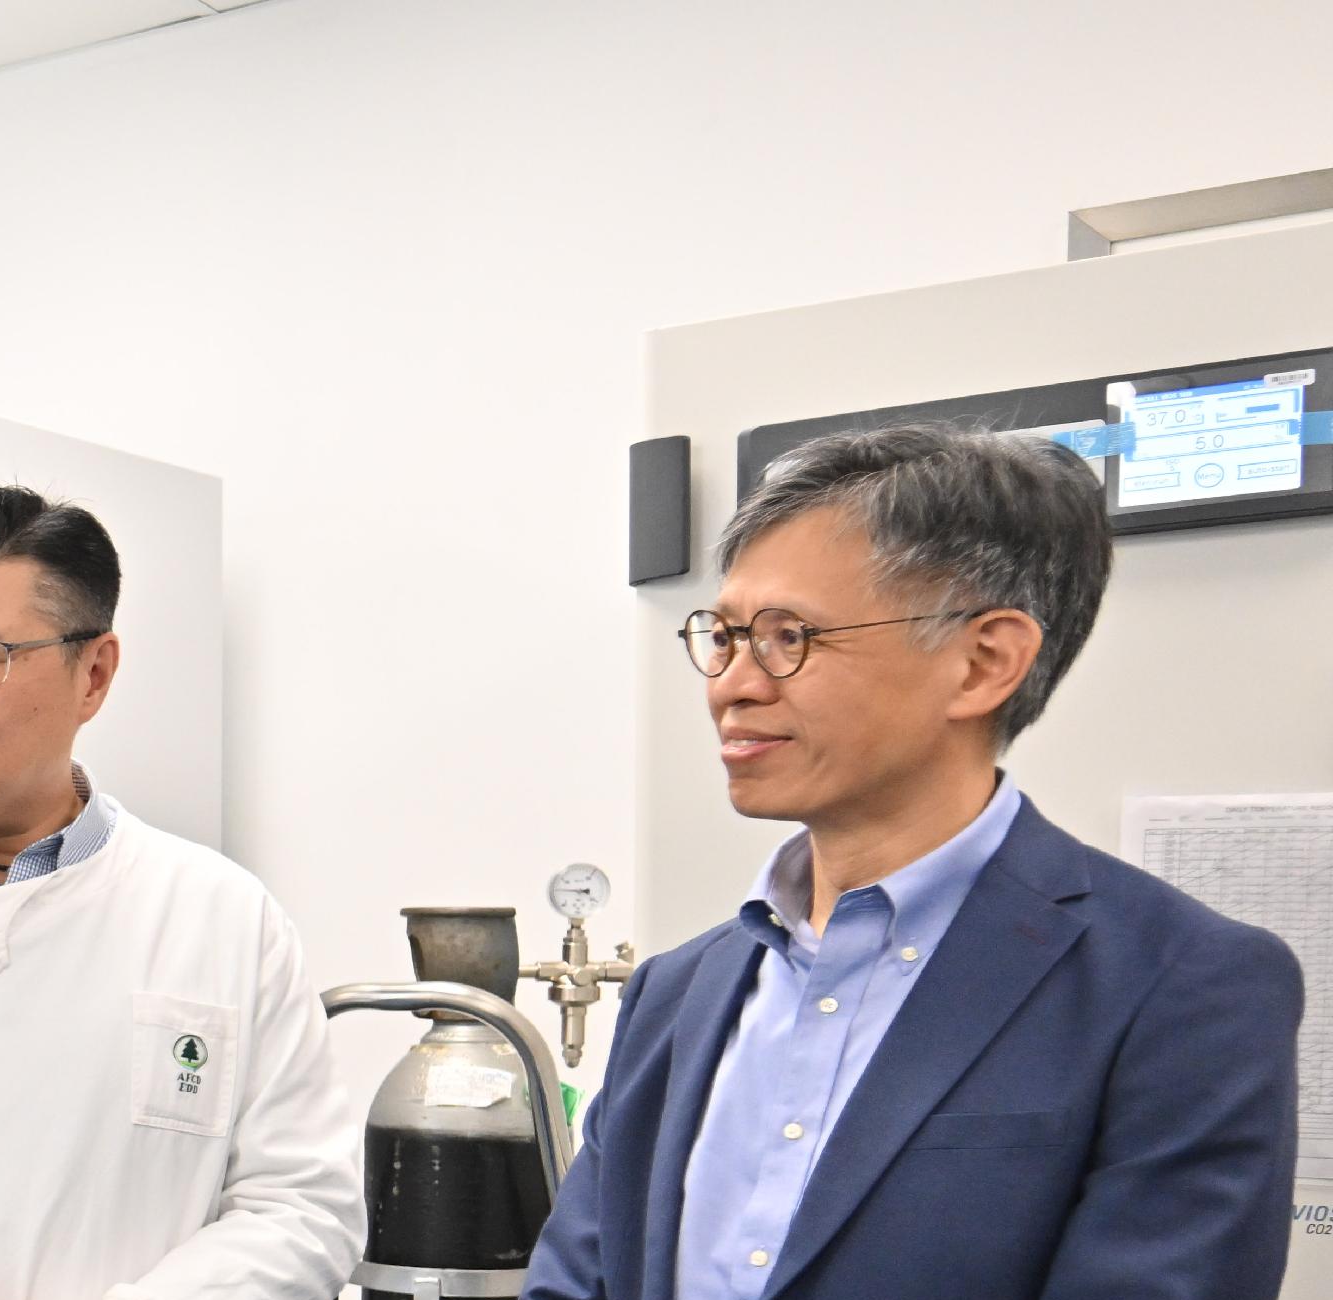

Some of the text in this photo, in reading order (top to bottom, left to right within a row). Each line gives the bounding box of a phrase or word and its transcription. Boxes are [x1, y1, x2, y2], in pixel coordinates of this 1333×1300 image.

[1196, 471, 1222, 482] Menu
[1289, 1204, 1333, 1222] VIO
[1306, 1223, 1333, 1235] CO2
